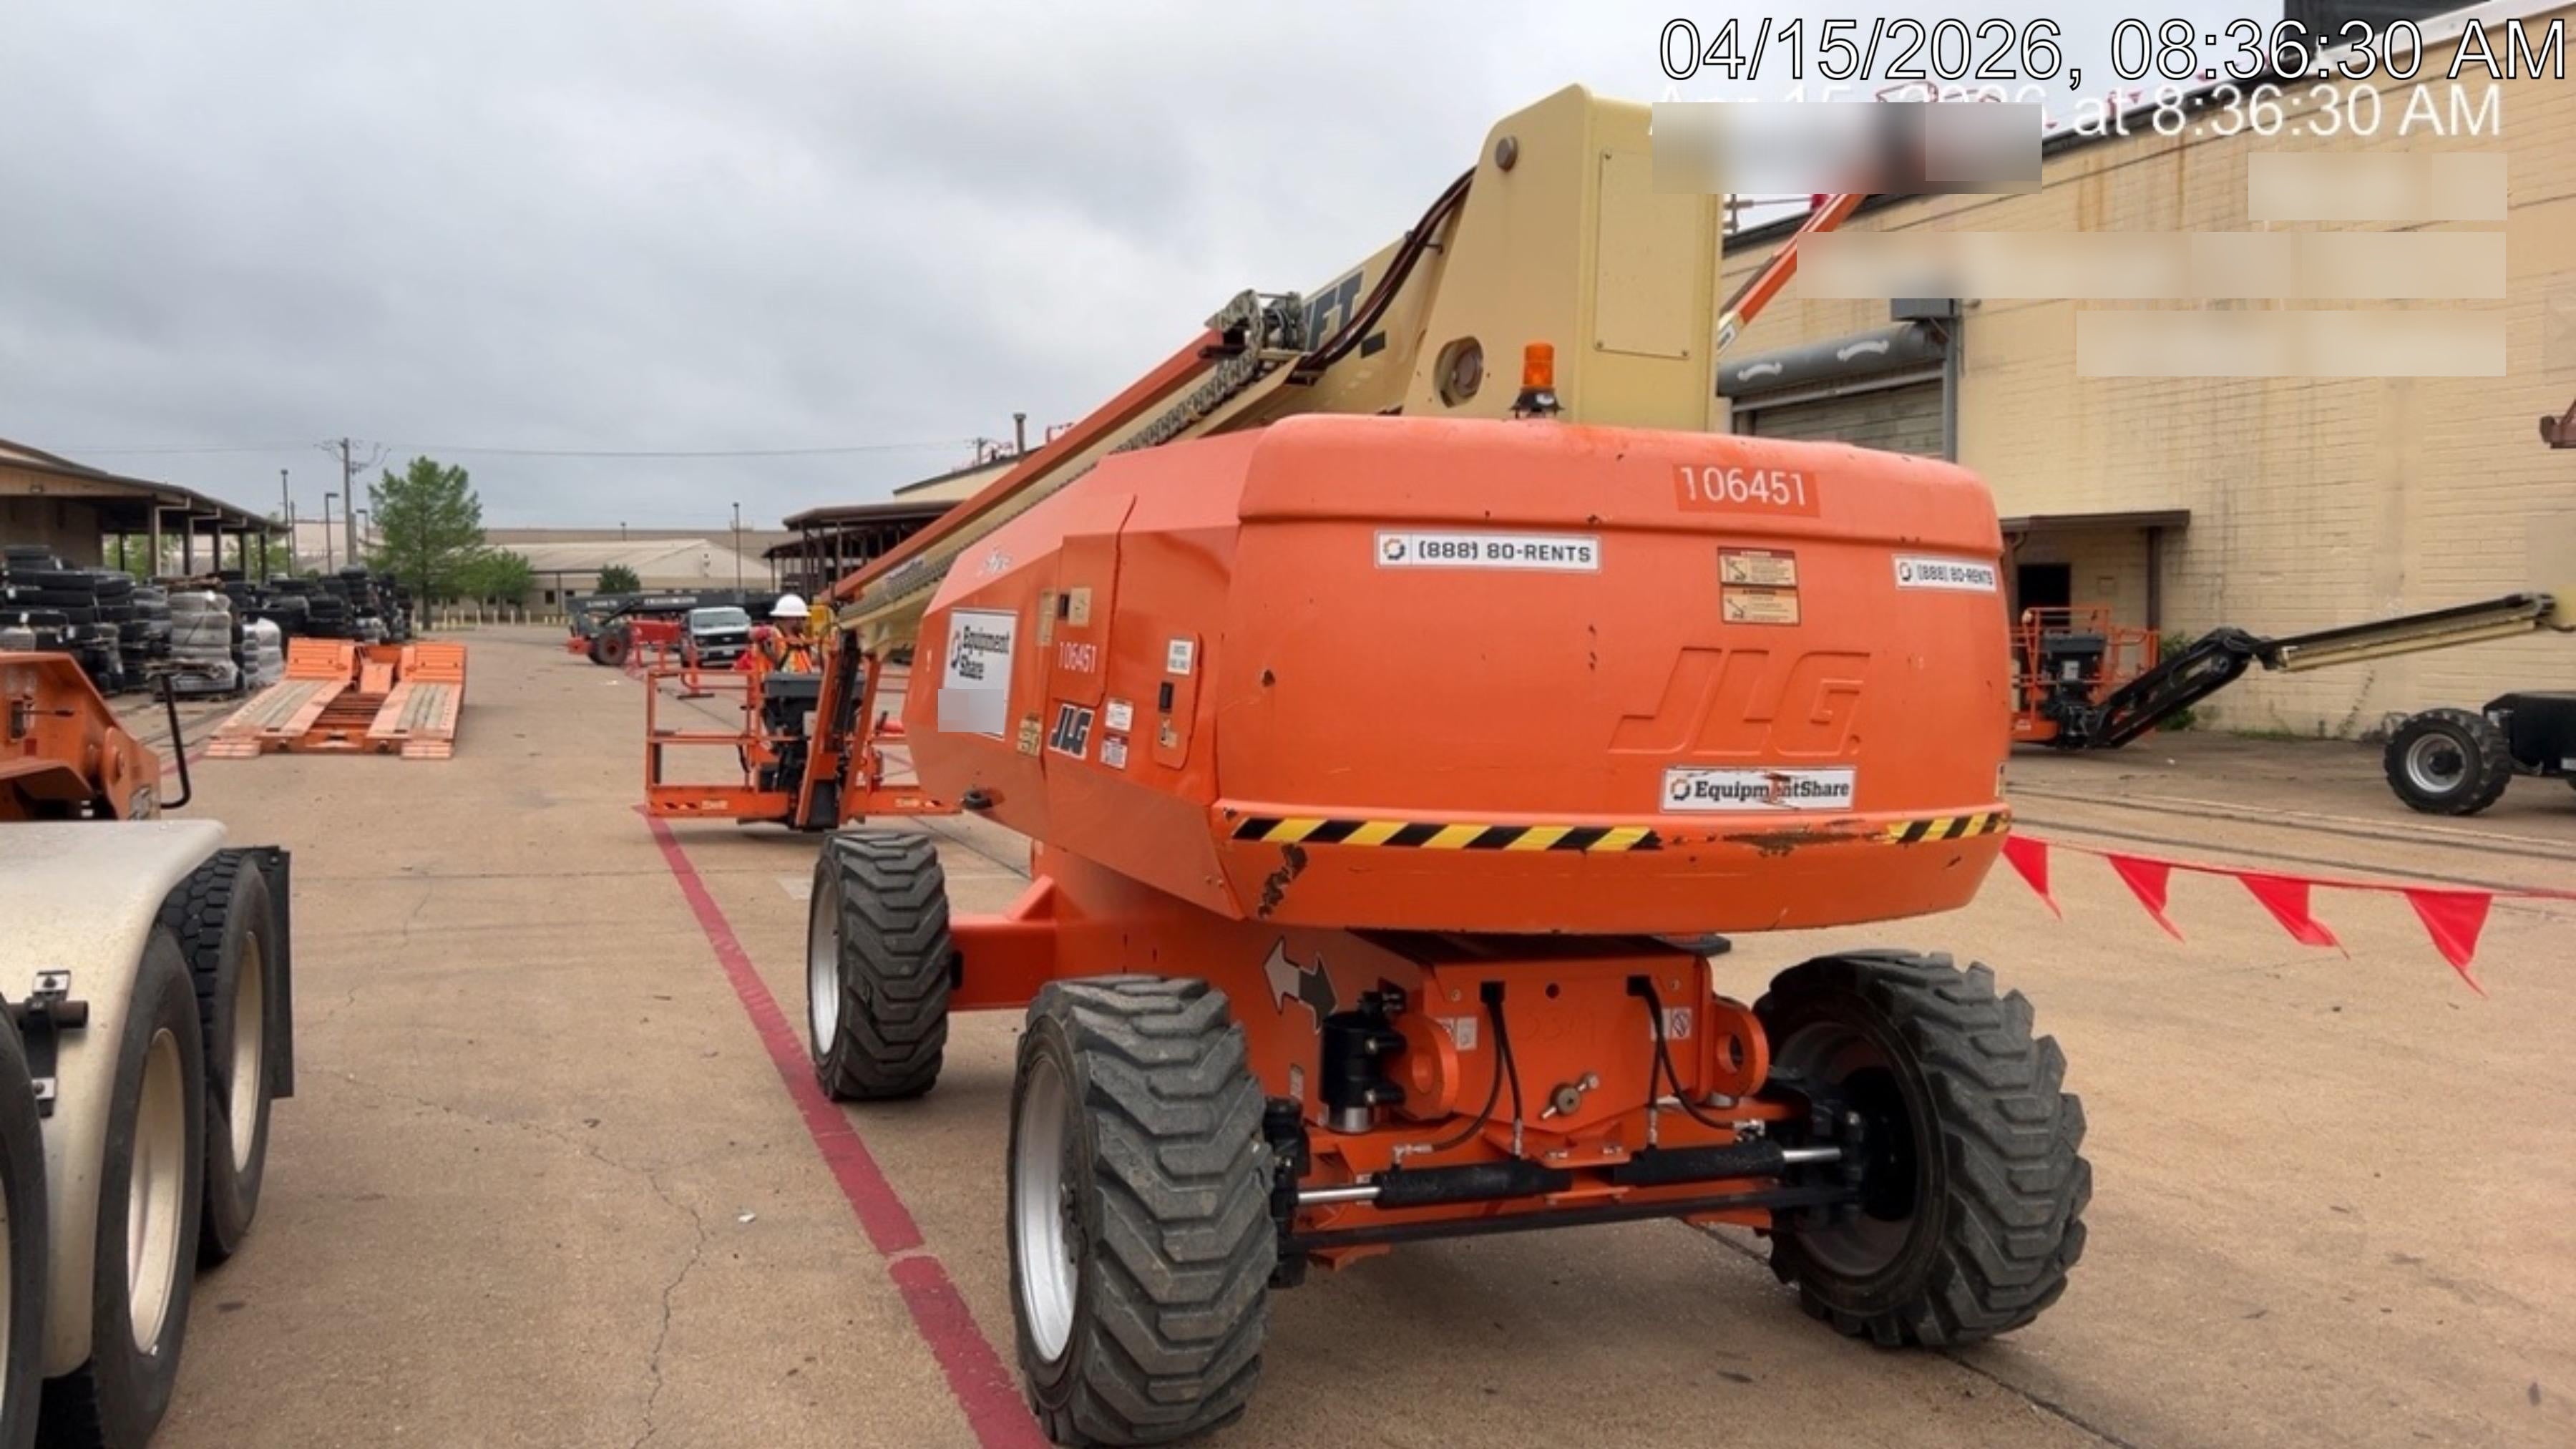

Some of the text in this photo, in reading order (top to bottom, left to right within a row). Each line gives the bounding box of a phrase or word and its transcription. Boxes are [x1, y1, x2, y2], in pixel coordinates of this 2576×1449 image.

[1680, 467, 1806, 506] 106451
[1419, 540, 1591, 562] (888) 80-RENTS
[1608, 646, 1870, 756] JLG
[1050, 705, 1093, 756] JLG
[1695, 781, 1849, 802] EquipmntShare
